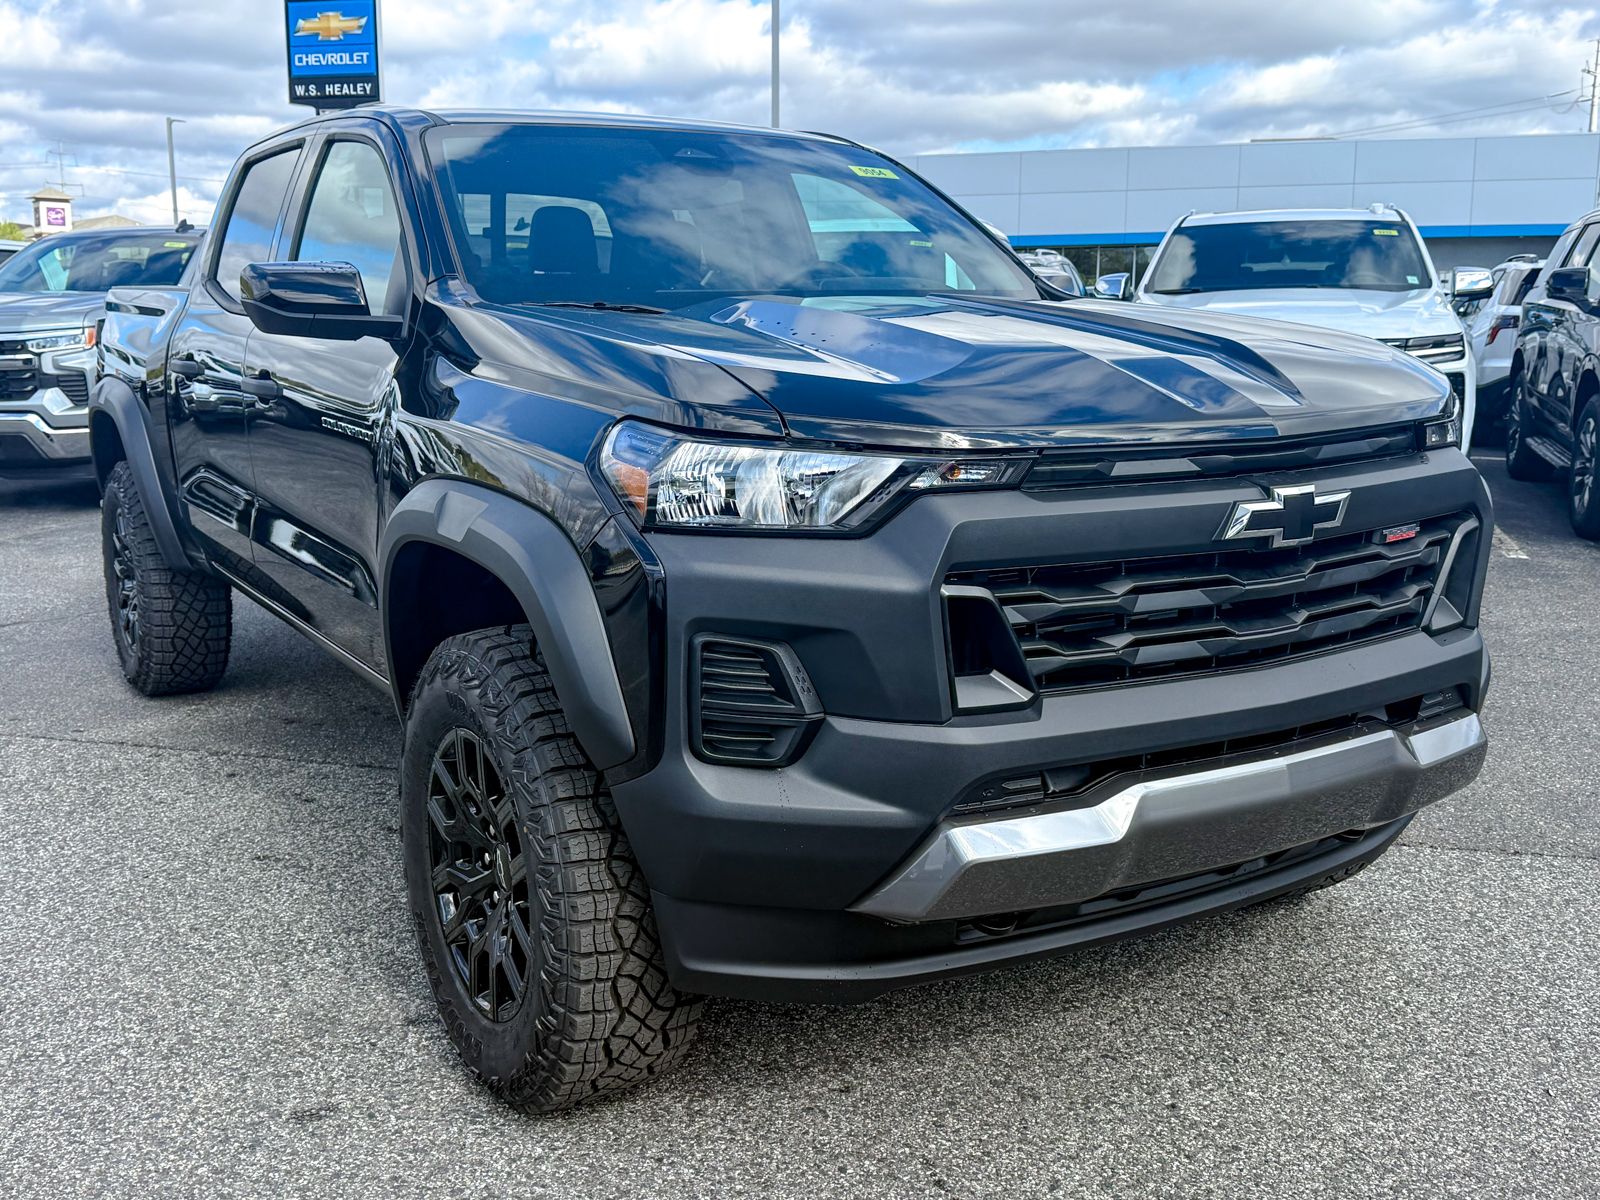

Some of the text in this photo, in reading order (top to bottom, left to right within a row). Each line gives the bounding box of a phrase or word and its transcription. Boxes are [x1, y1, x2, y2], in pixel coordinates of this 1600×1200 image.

[294, 52, 370, 67] CHEVROLET
[294, 82, 373, 97] W.S. HEALEY
